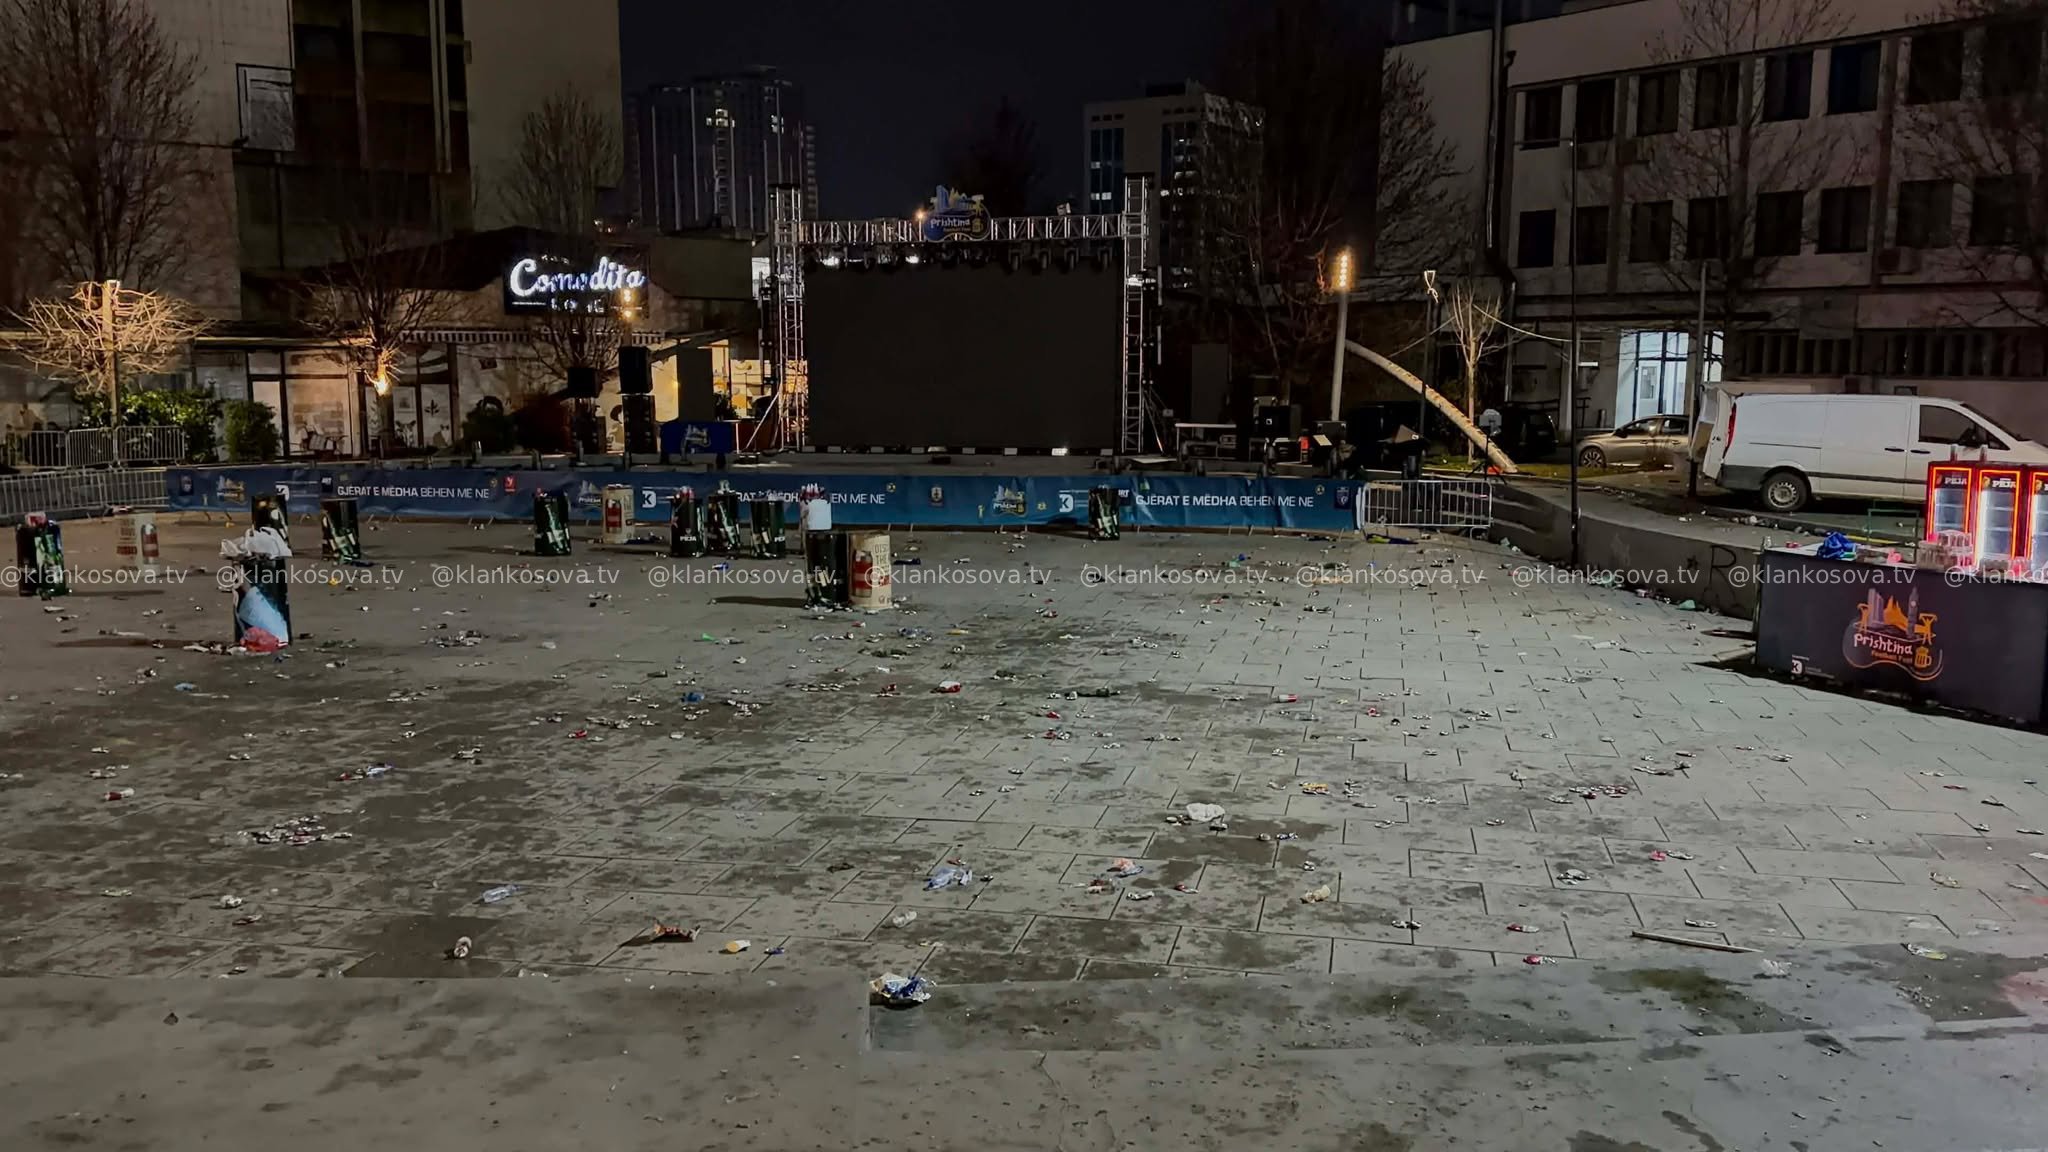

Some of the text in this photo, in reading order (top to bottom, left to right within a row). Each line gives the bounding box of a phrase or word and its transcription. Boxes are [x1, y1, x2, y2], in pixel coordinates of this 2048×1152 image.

[373, 486, 379, 496] E
[457, 488, 472, 499] ME
[849, 493, 868, 504] ME
[870, 493, 885, 504] NE
[1182, 495, 1190, 506] E
[1278, 495, 1296, 507] ME
[1298, 496, 1314, 507] NE
